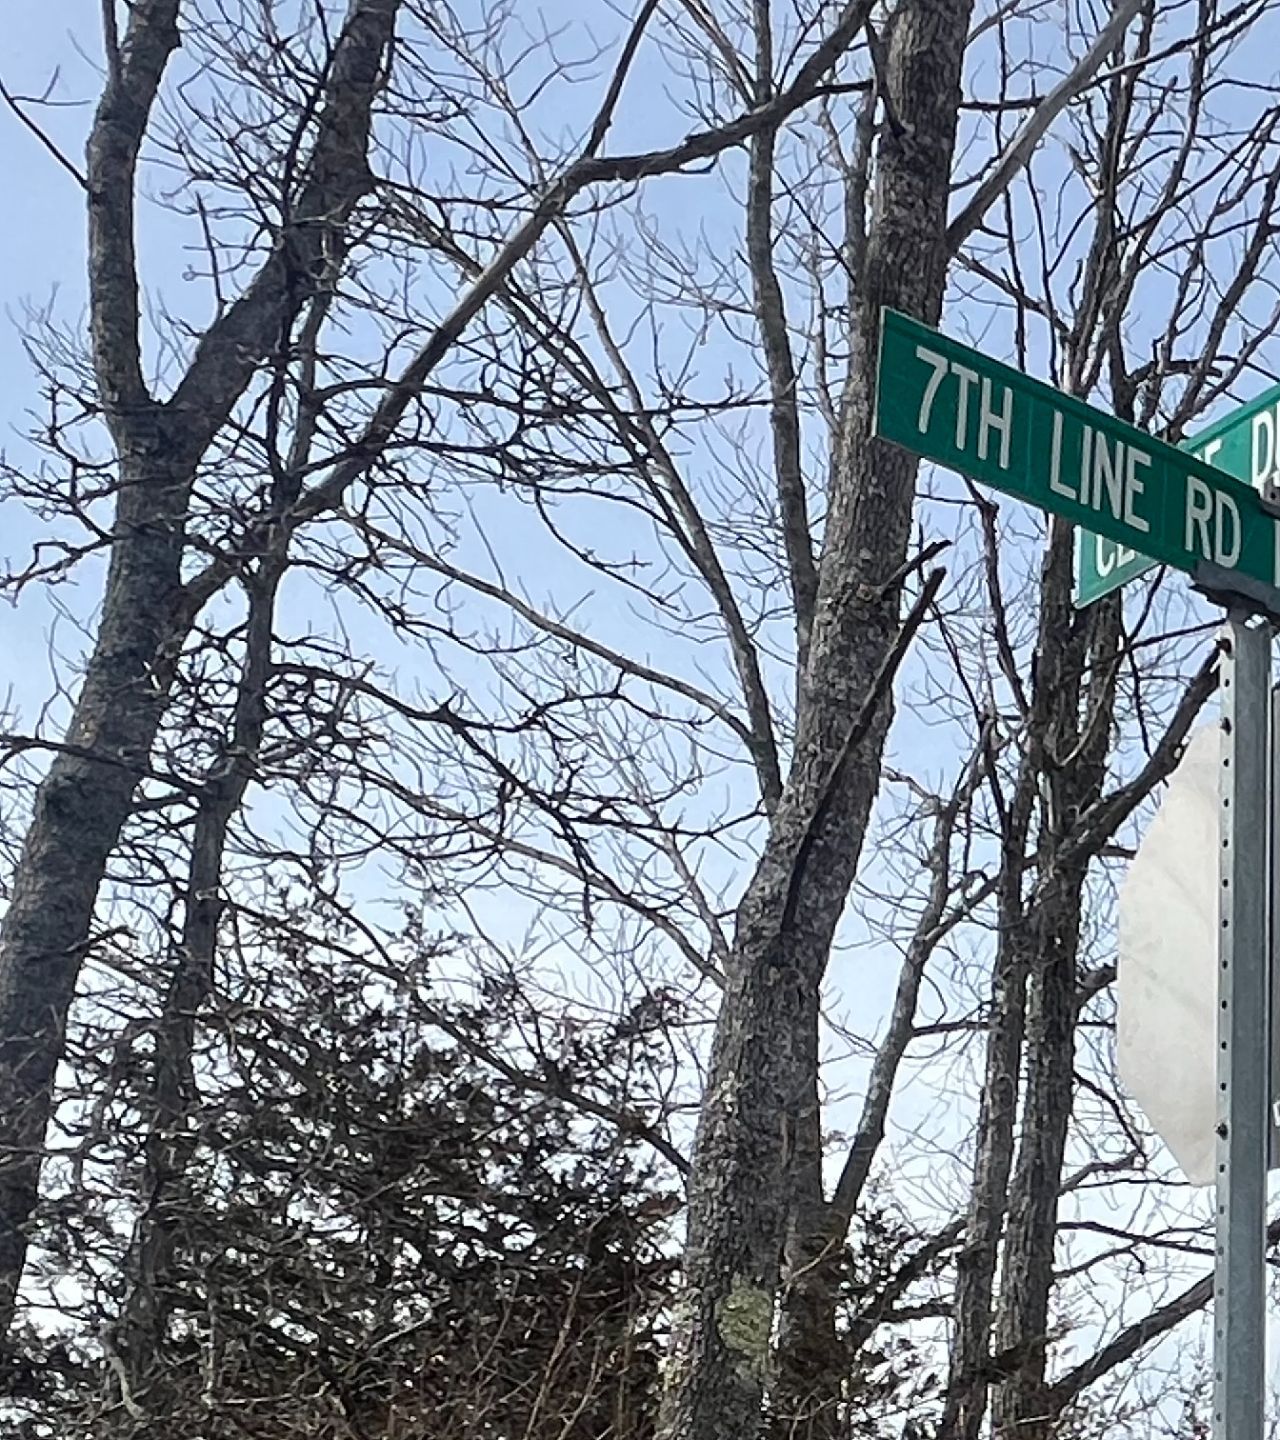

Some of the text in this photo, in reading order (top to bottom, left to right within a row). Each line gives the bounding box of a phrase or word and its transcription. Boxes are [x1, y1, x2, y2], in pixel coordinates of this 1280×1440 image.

[915, 345, 1013, 470] 7TH
[1049, 410, 1153, 533] LINE
[1184, 475, 1242, 568] RD
